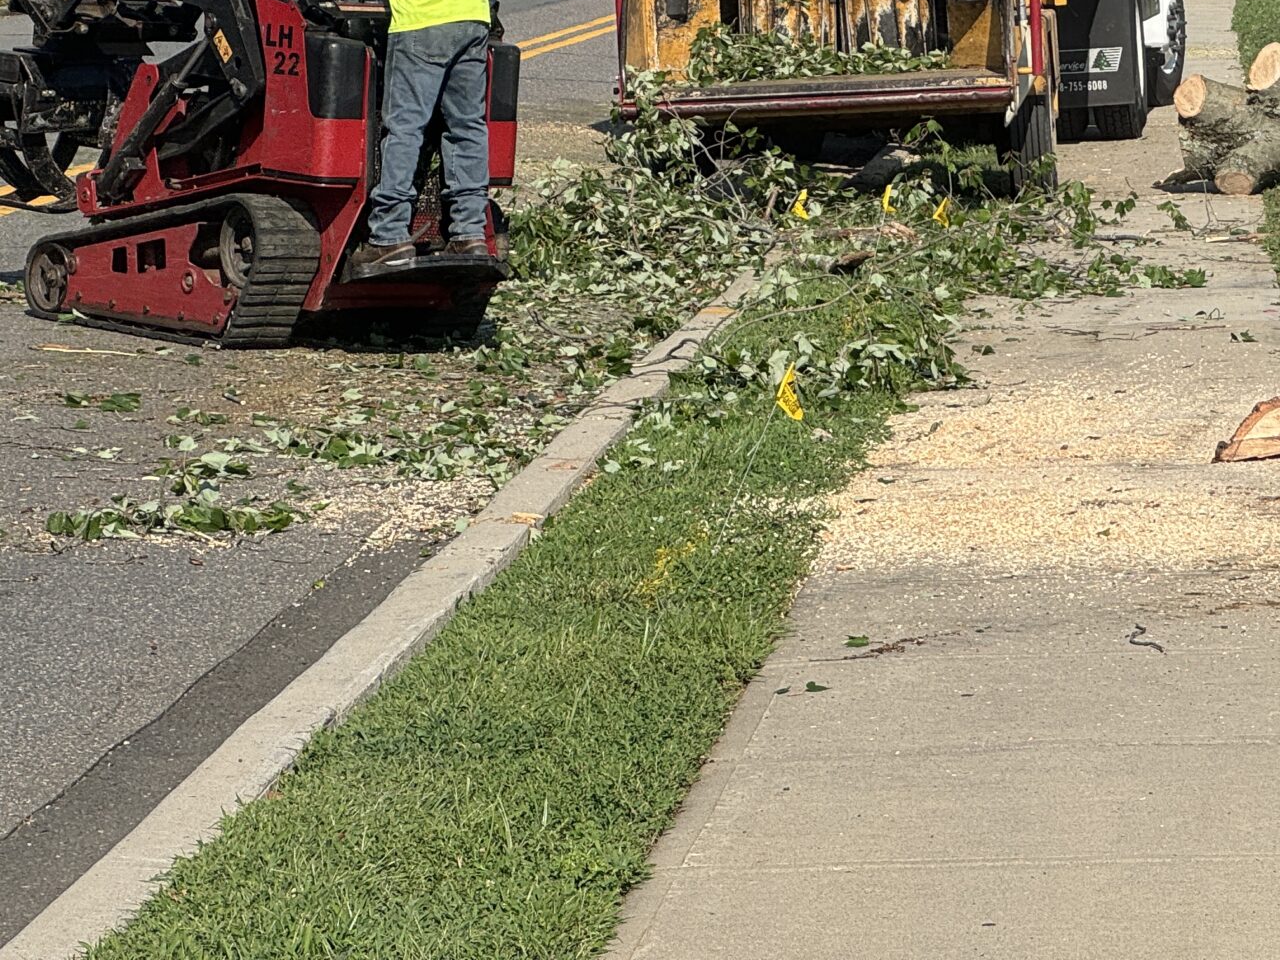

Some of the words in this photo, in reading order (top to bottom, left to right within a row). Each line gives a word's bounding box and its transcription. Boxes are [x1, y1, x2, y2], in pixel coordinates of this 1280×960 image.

[265, 23, 294, 49] LH
[273, 51, 301, 77] 22
[1060, 61, 1086, 70] ervice
[1059, 80, 1108, 92] 8-755-6008
